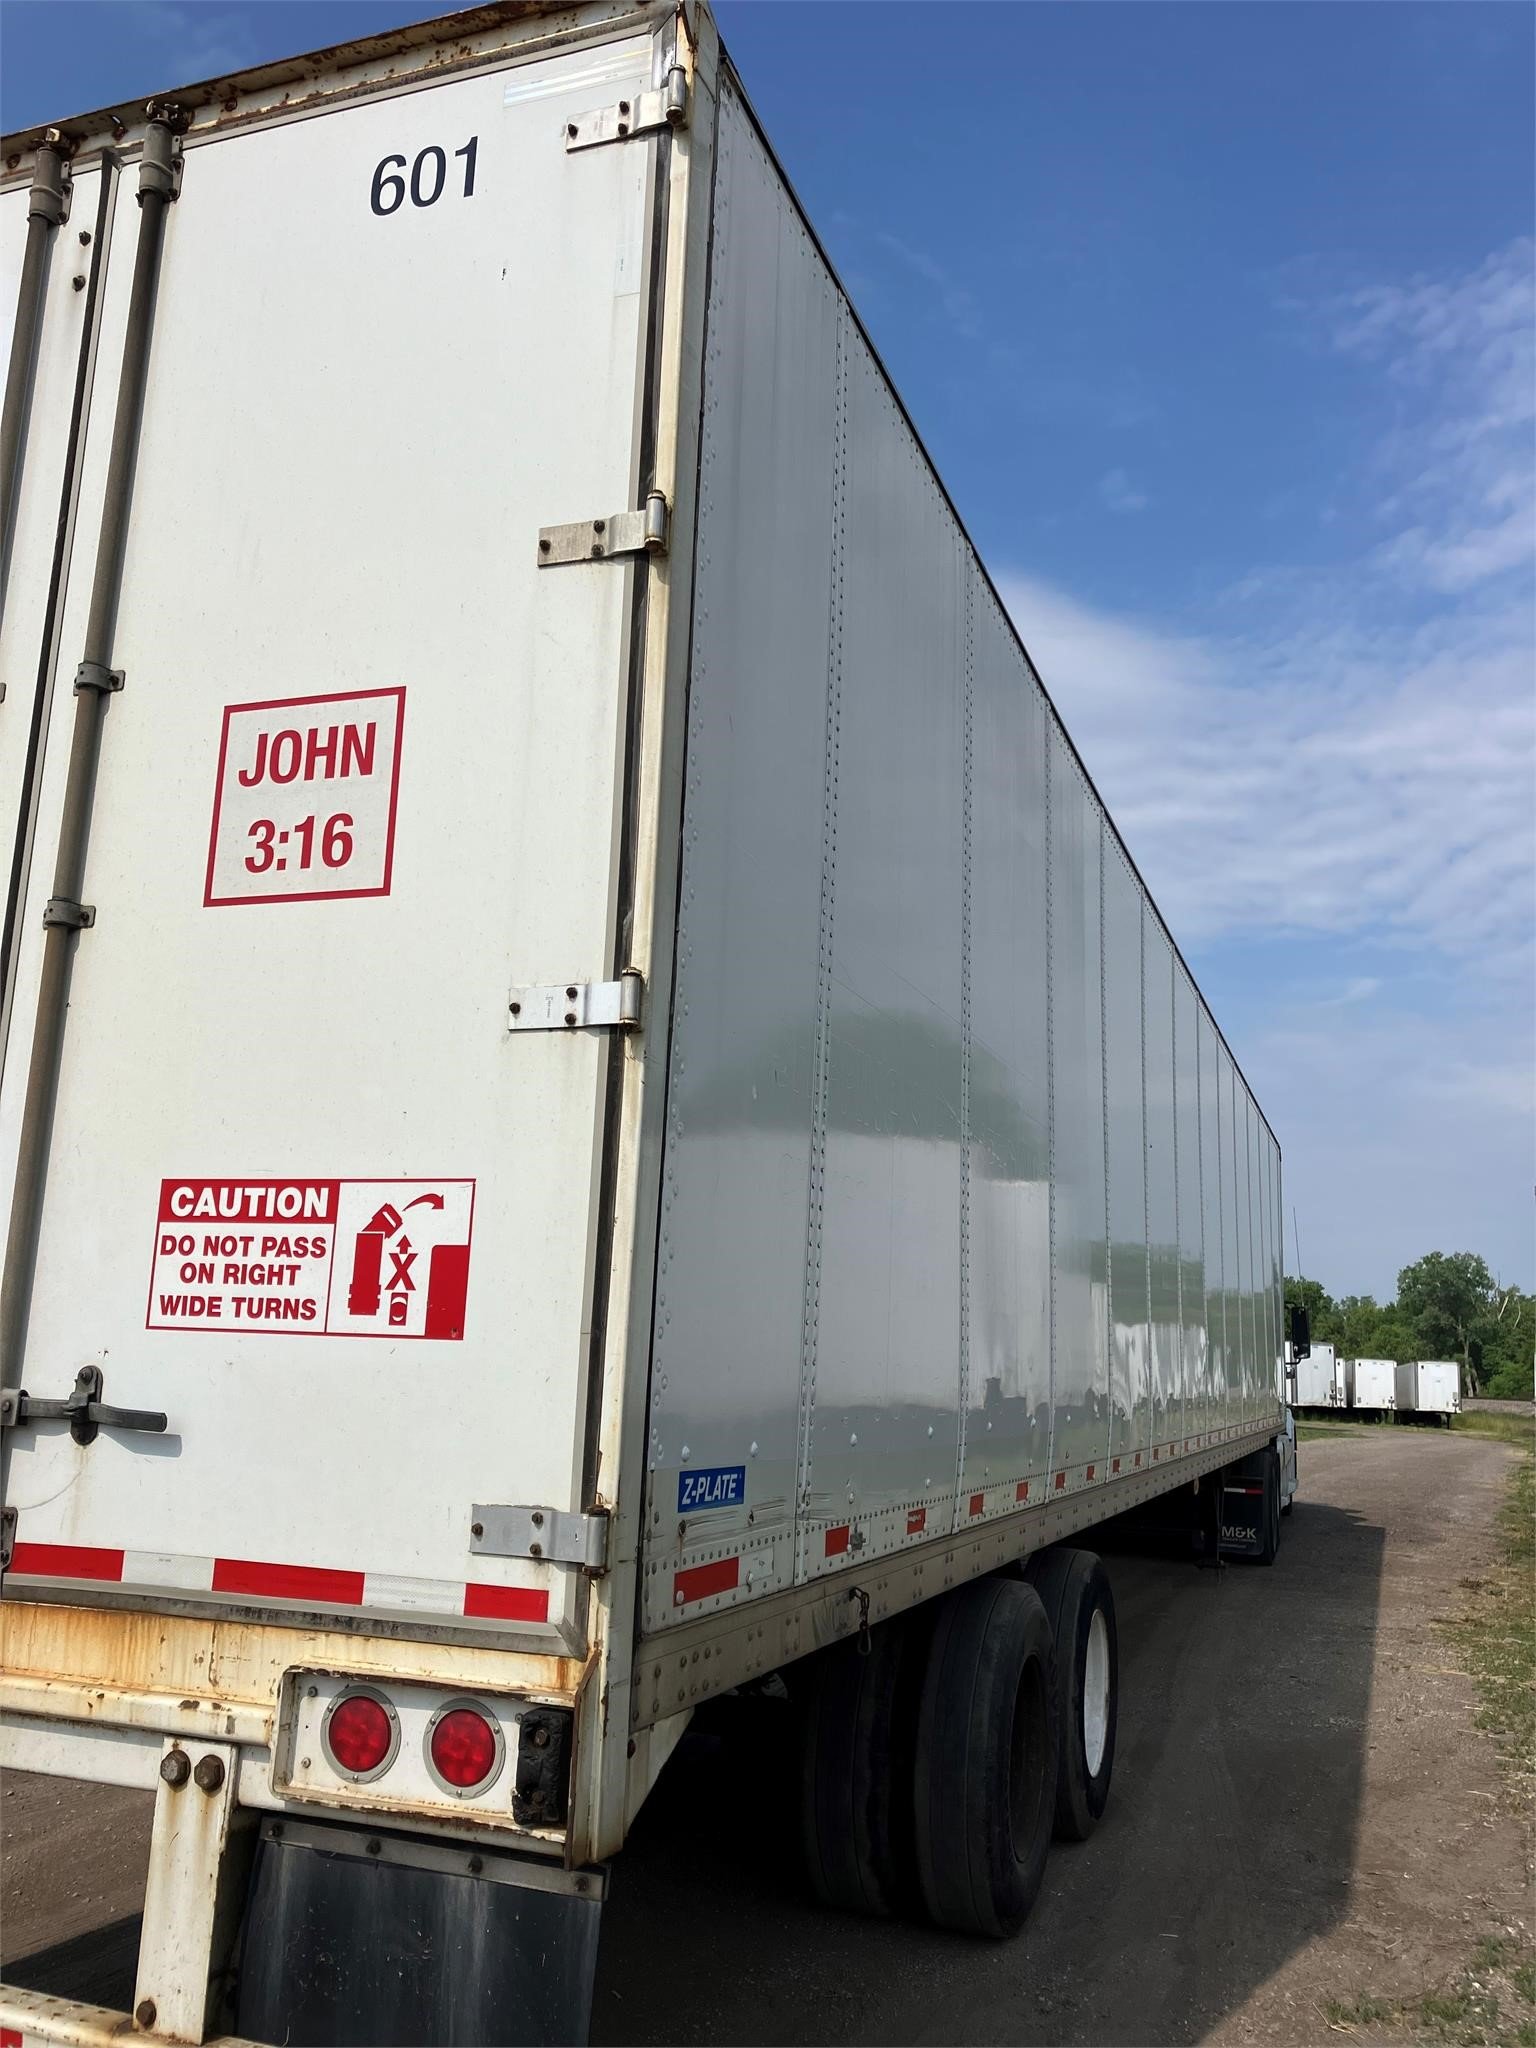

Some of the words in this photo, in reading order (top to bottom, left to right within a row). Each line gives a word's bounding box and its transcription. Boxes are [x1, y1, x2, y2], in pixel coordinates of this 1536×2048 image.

[370, 135, 478, 216] 601
[238, 722, 377, 788] JOHN
[244, 813, 354, 874] 3:16
[170, 1186, 330, 1218] CAUTION
[160, 1235, 196, 1256] DO
[203, 1236, 254, 1257] NOT
[261, 1236, 327, 1259] PASS
[179, 1262, 215, 1284] ON
[223, 1264, 302, 1286] RIGHT
[160, 1294, 222, 1317] WIDE
[231, 1297, 317, 1321] TURNS
[681, 1473, 738, 1505] Z-PLATE
[1221, 1526, 1257, 1539] M&K
